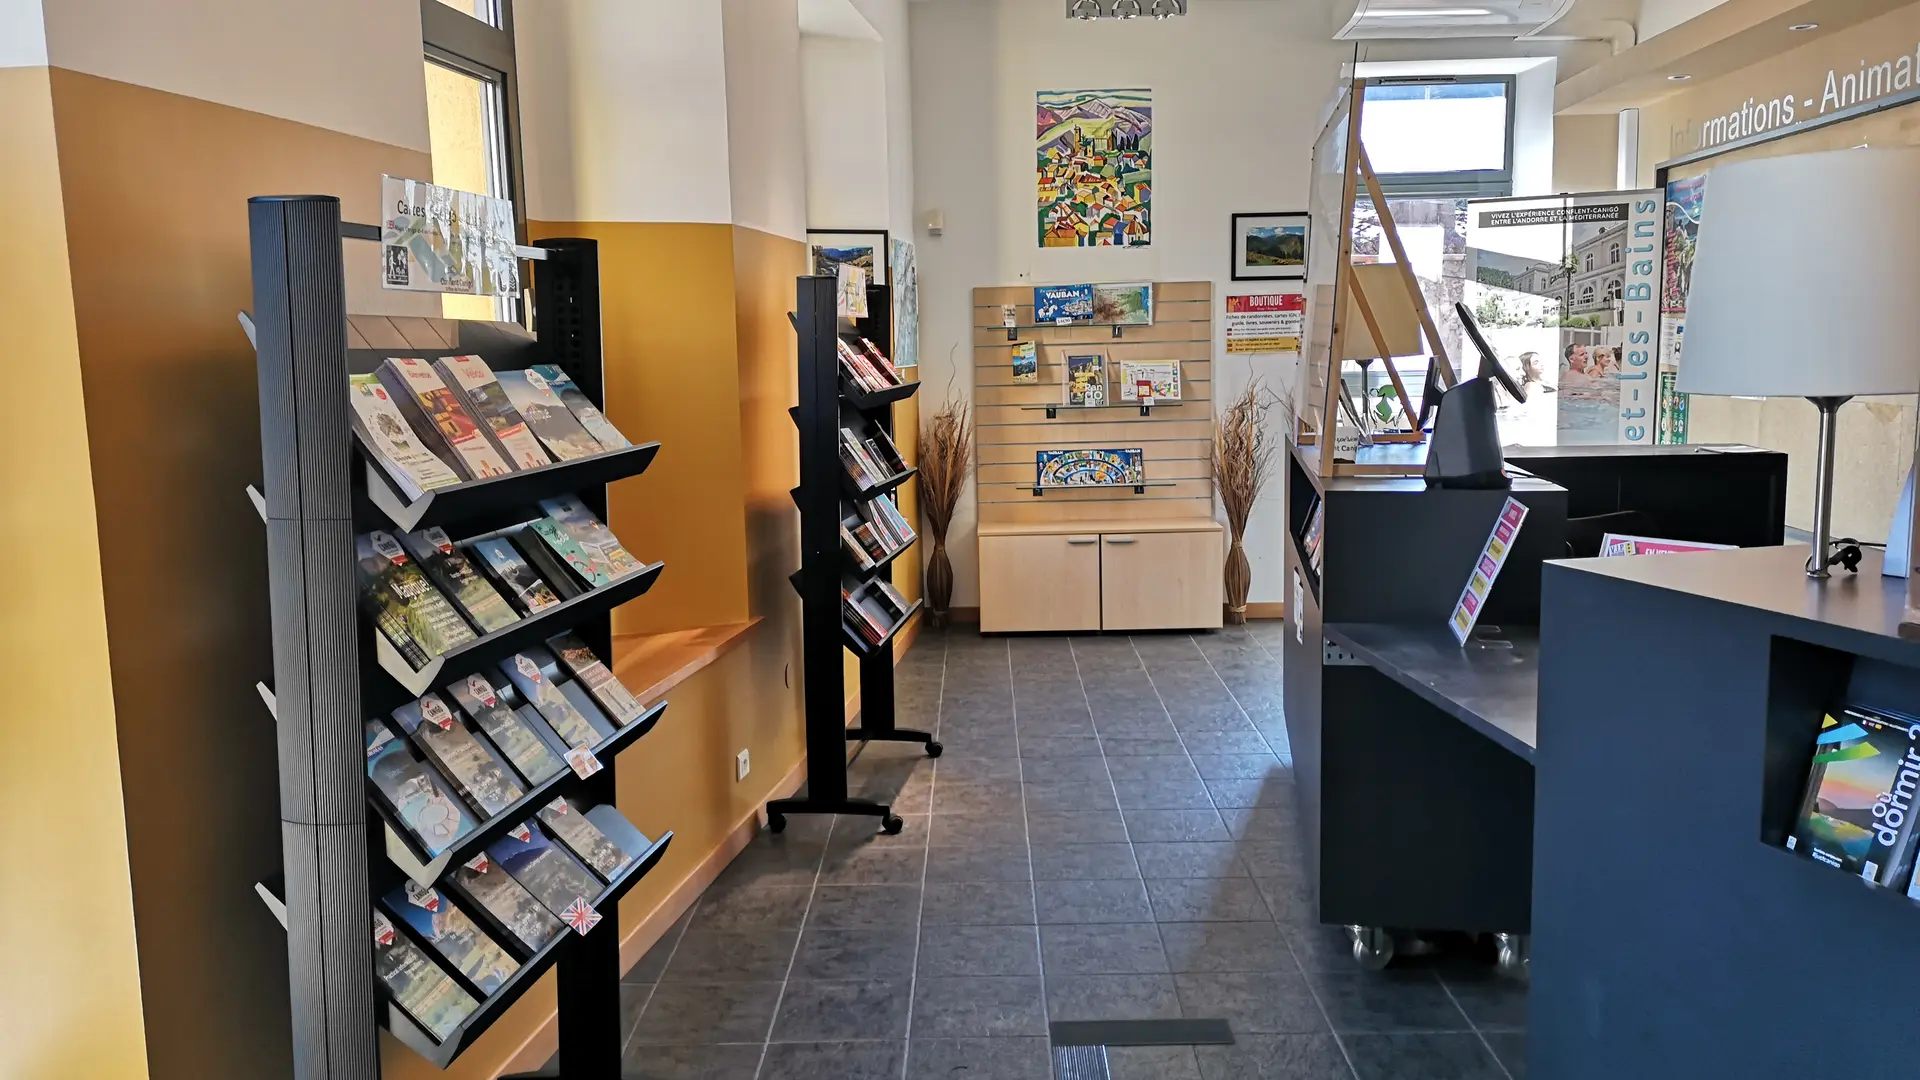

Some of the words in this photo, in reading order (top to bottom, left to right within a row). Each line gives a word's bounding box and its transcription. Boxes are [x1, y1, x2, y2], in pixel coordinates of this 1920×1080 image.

[1511, 208, 1555, 218] L'EXPÉRIENCE
[1491, 218, 1512, 226] ENTRE
[1512, 217, 1549, 225] L'ANDORRE
[1046, 290, 1080, 299] VAUBAN
[1249, 295, 1283, 306] BOUTIQUE
[1085, 383, 1103, 391] Ran
[1085, 391, 1103, 400] do
[390, 575, 432, 600] Magique!
[1872, 747, 1920, 847] dormir
[1872, 792, 1893, 818] où
